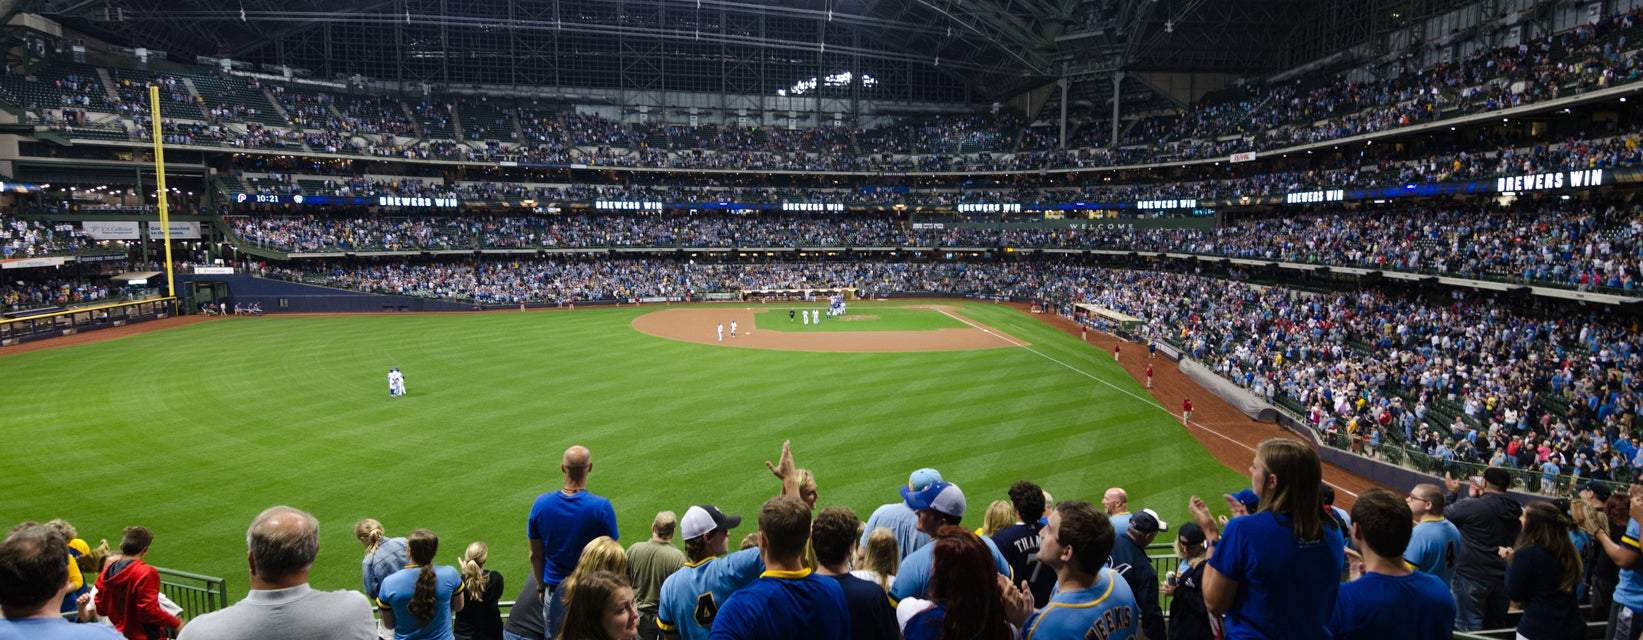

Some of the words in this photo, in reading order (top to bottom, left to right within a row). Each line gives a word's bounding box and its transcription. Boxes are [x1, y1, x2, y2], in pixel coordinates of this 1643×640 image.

[1497, 172, 1563, 192] BREWERS
[1570, 169, 1602, 187] WIN
[256, 195, 279, 203] 10:21
[380, 197, 431, 207] BREWERS
[435, 198, 457, 207] WIN
[1287, 191, 1323, 204] BREWERS
[1326, 190, 1343, 201] WIN
[596, 201, 640, 210] BREWERS
[644, 202, 662, 210] WIN
[783, 203, 824, 211] BREWERS
[827, 203, 843, 211] WIN
[958, 204, 1000, 212] BREWERS
[1003, 204, 1020, 212] WIN
[1137, 200, 1177, 209] BREWERS
[1180, 199, 1196, 208] WIN
[694, 591, 718, 627] 4
[1084, 606, 1131, 640] WEEKS
